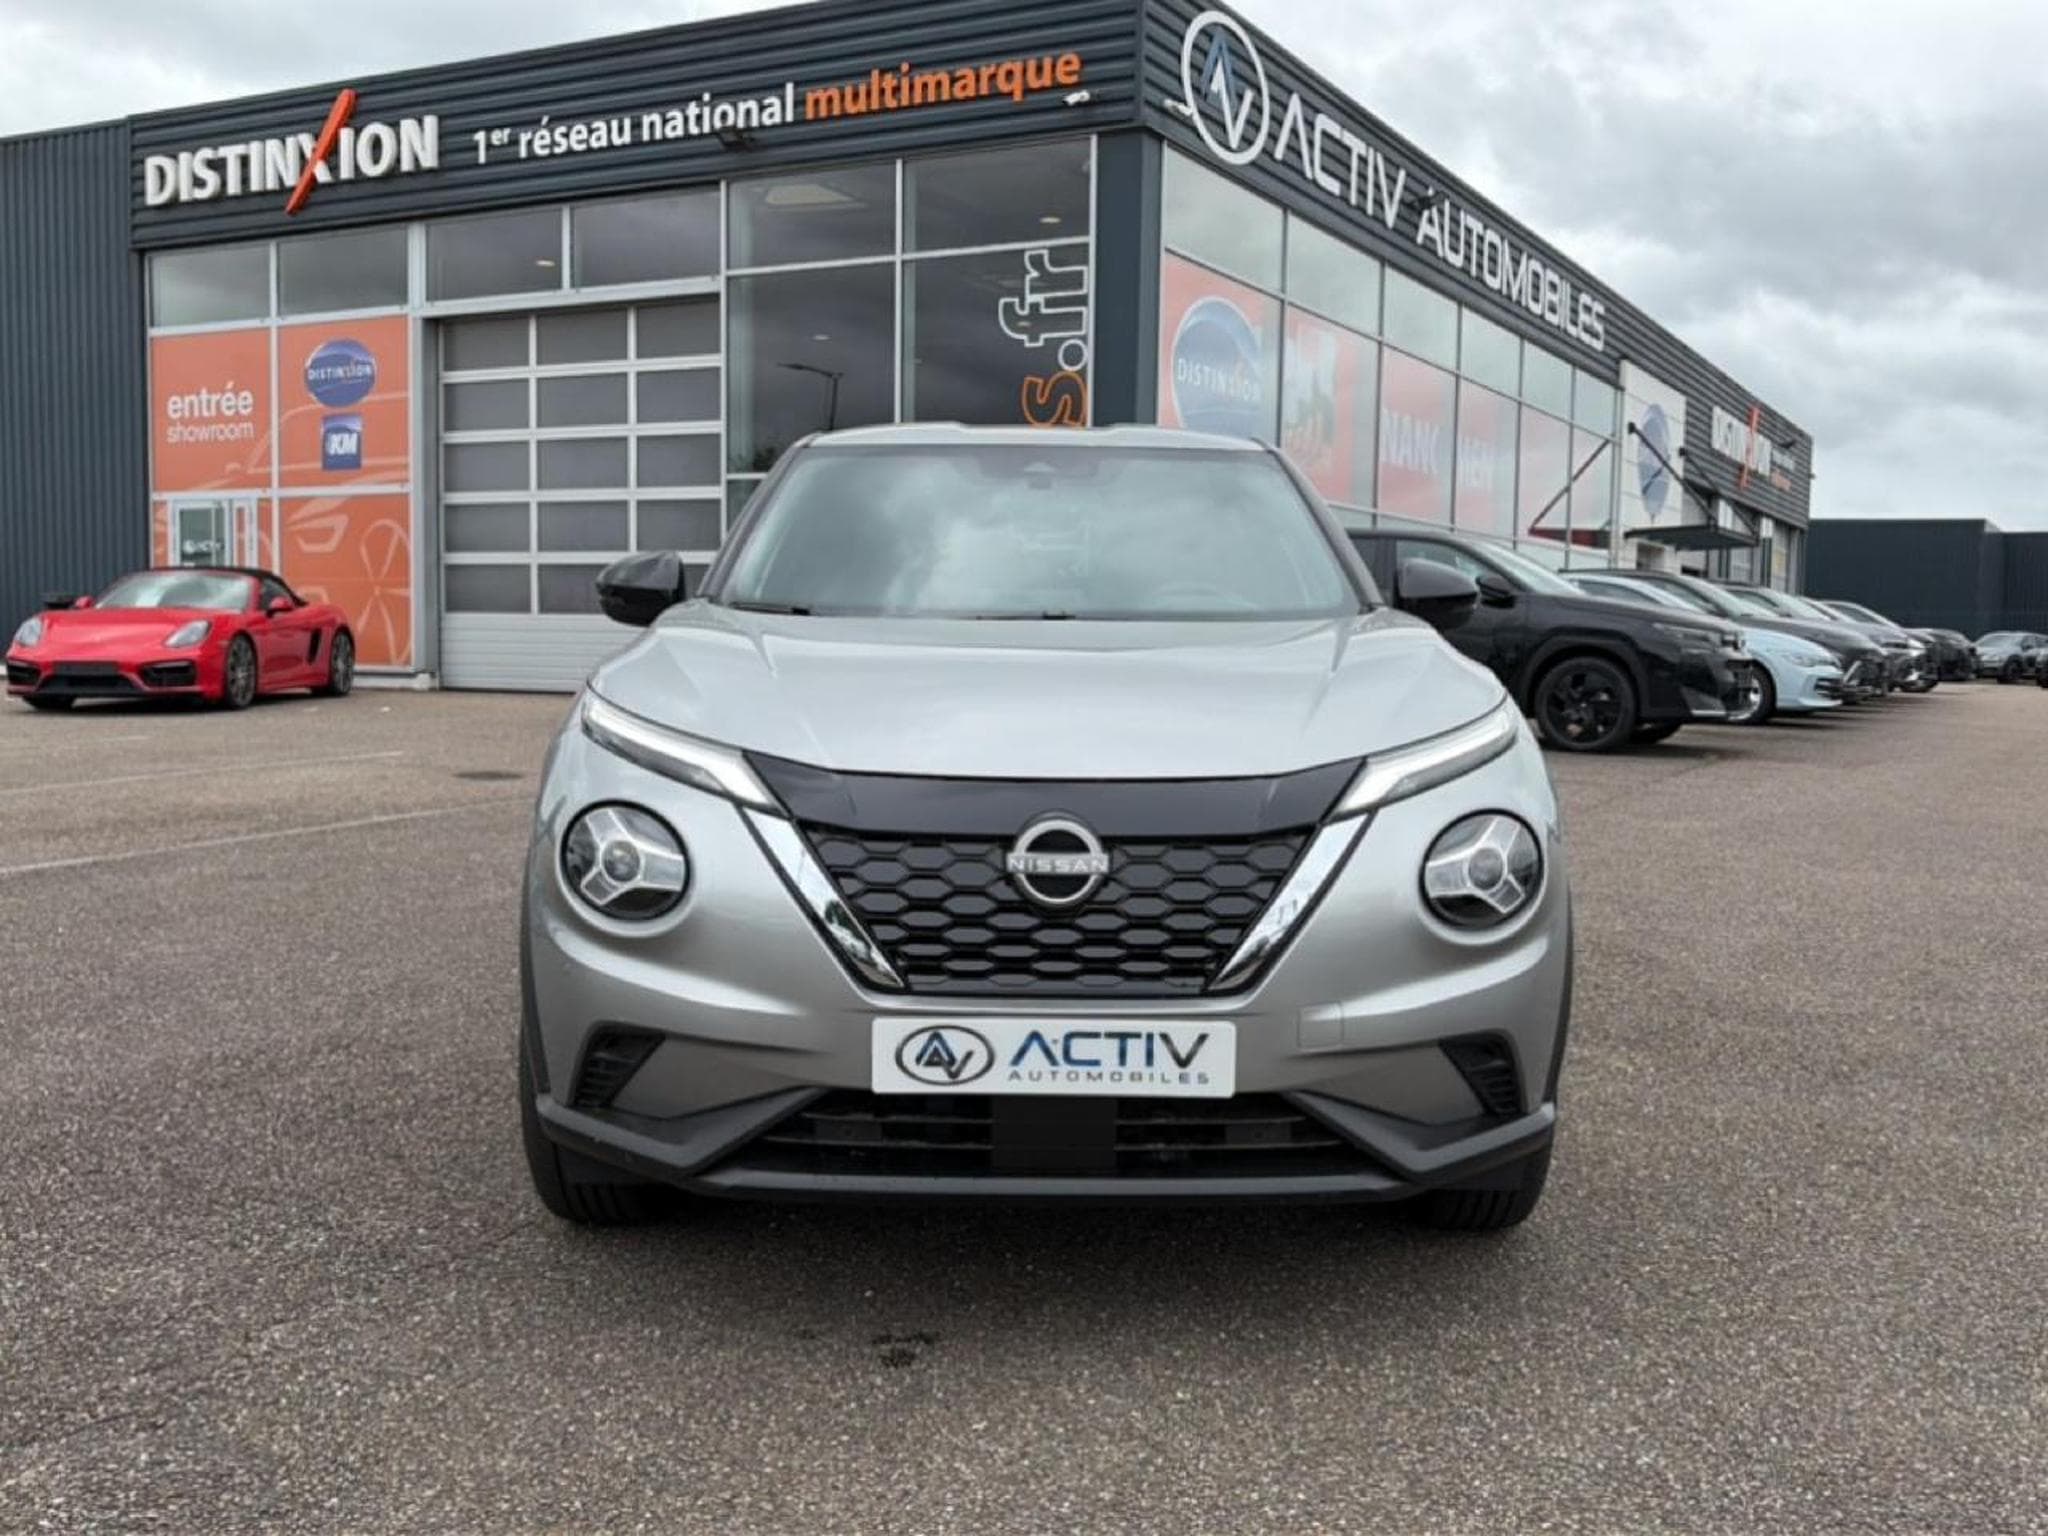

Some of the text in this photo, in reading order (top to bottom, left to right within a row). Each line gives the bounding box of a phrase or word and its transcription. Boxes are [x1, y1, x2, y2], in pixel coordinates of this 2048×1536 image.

[517, 114, 632, 159] réseau
[641, 81, 795, 142] national
[805, 51, 1083, 122] multimarque
[144, 87, 440, 215] DISTINXION
[1274, 92, 1605, 351] ACTIV AUTOMOBILES
[166, 380, 253, 419] entrée
[166, 420, 255, 443] showroom
[1007, 857, 1109, 873] NISSAN
[1010, 1030, 1210, 1068] ACTIV
[1008, 1070, 1210, 1085] AUTOMOBILES
